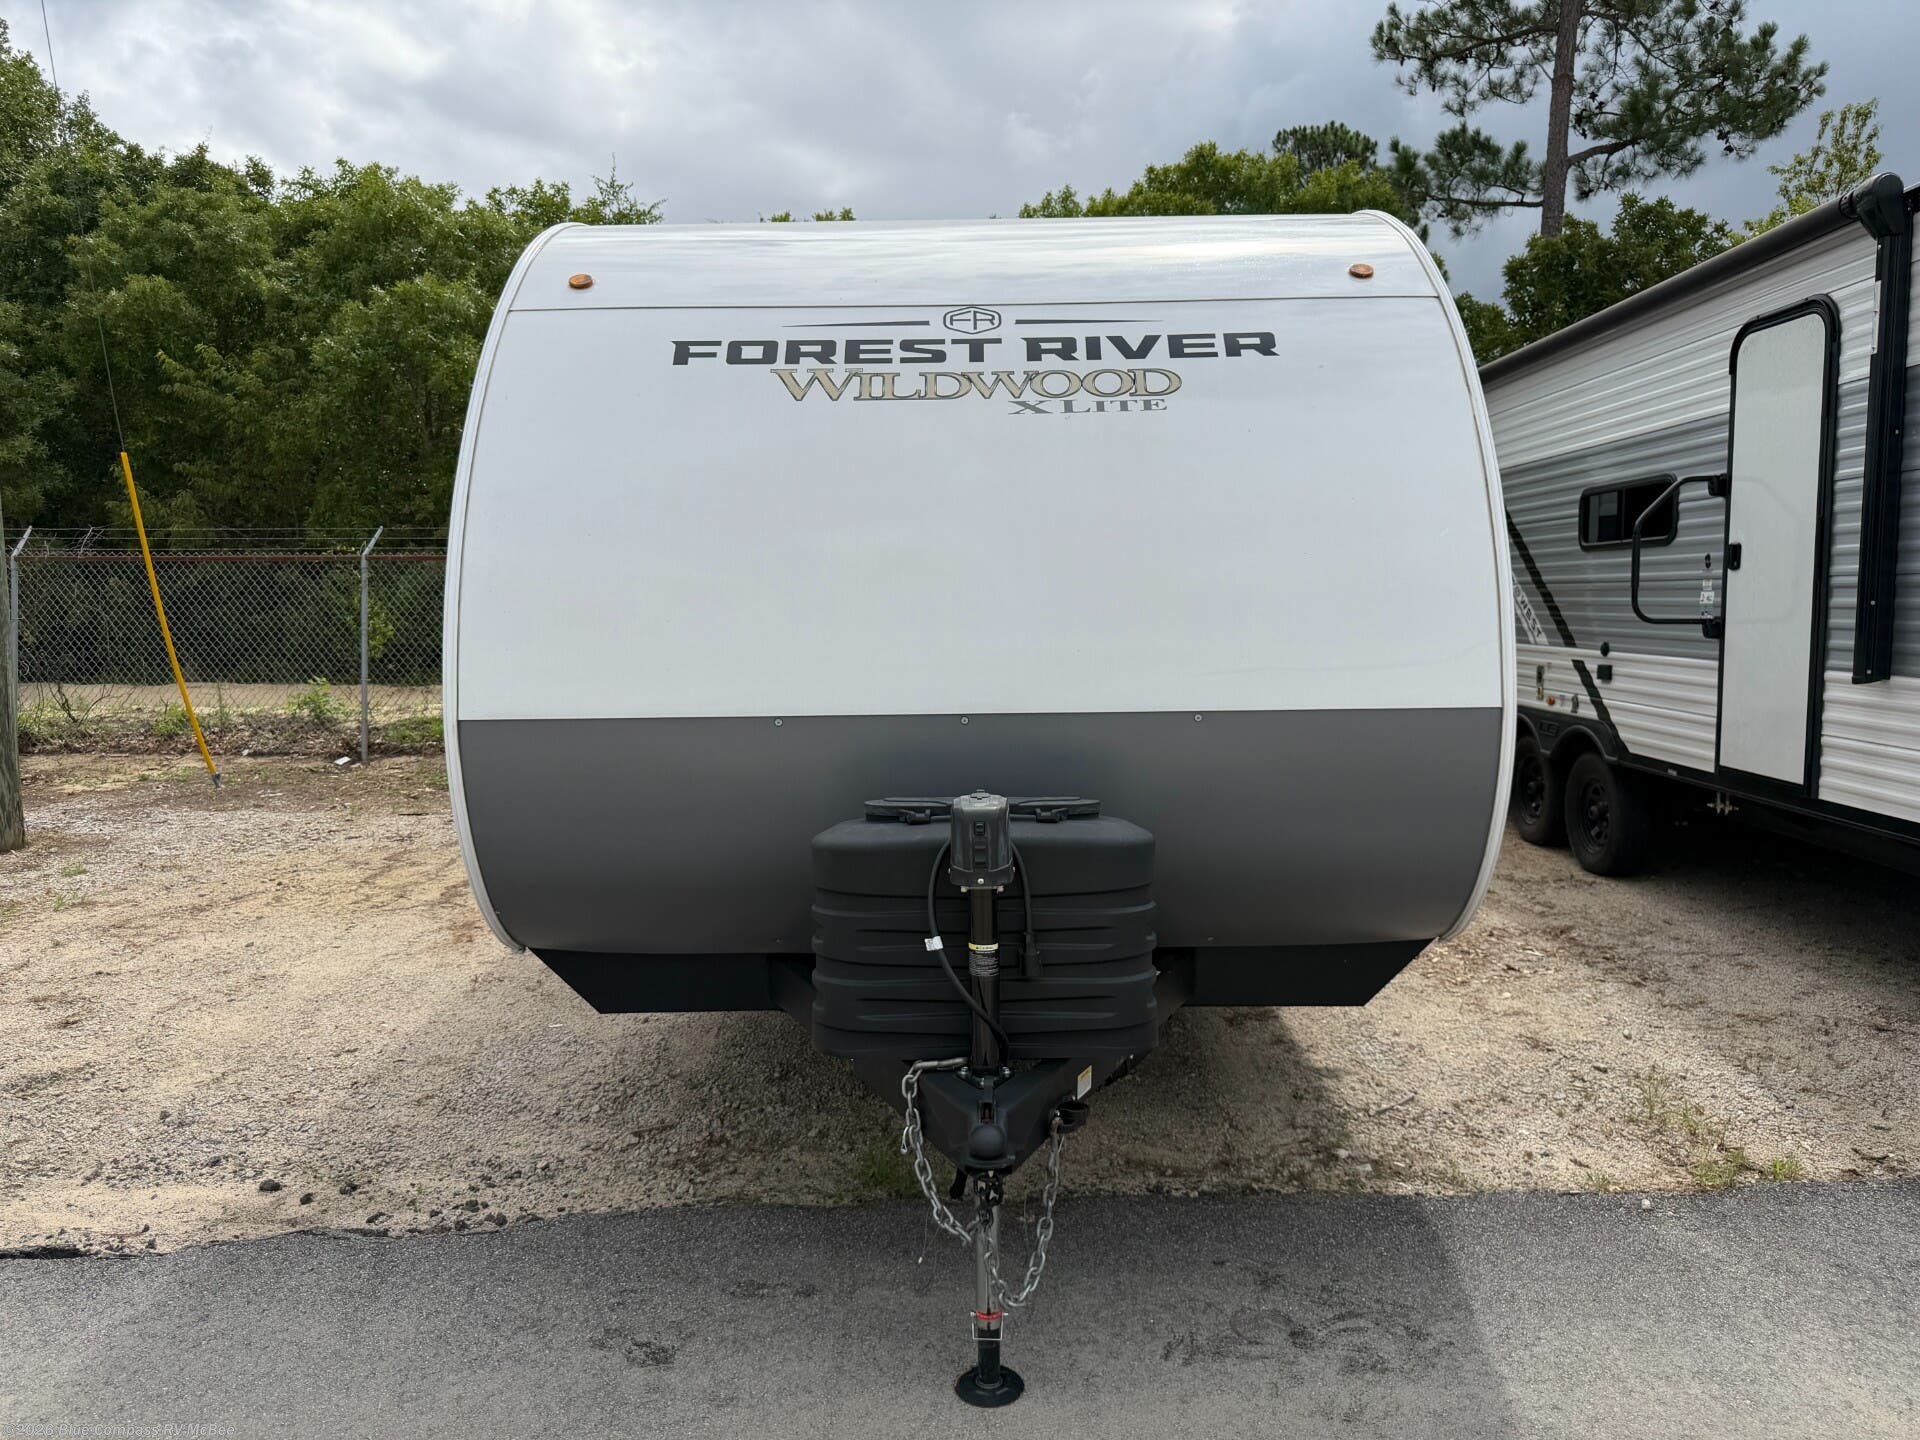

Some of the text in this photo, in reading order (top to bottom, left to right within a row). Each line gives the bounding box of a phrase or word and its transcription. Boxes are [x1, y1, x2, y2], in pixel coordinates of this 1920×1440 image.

[671, 332, 1280, 365] FOREST RIVER
[770, 367, 1183, 401] WILDWOOD
